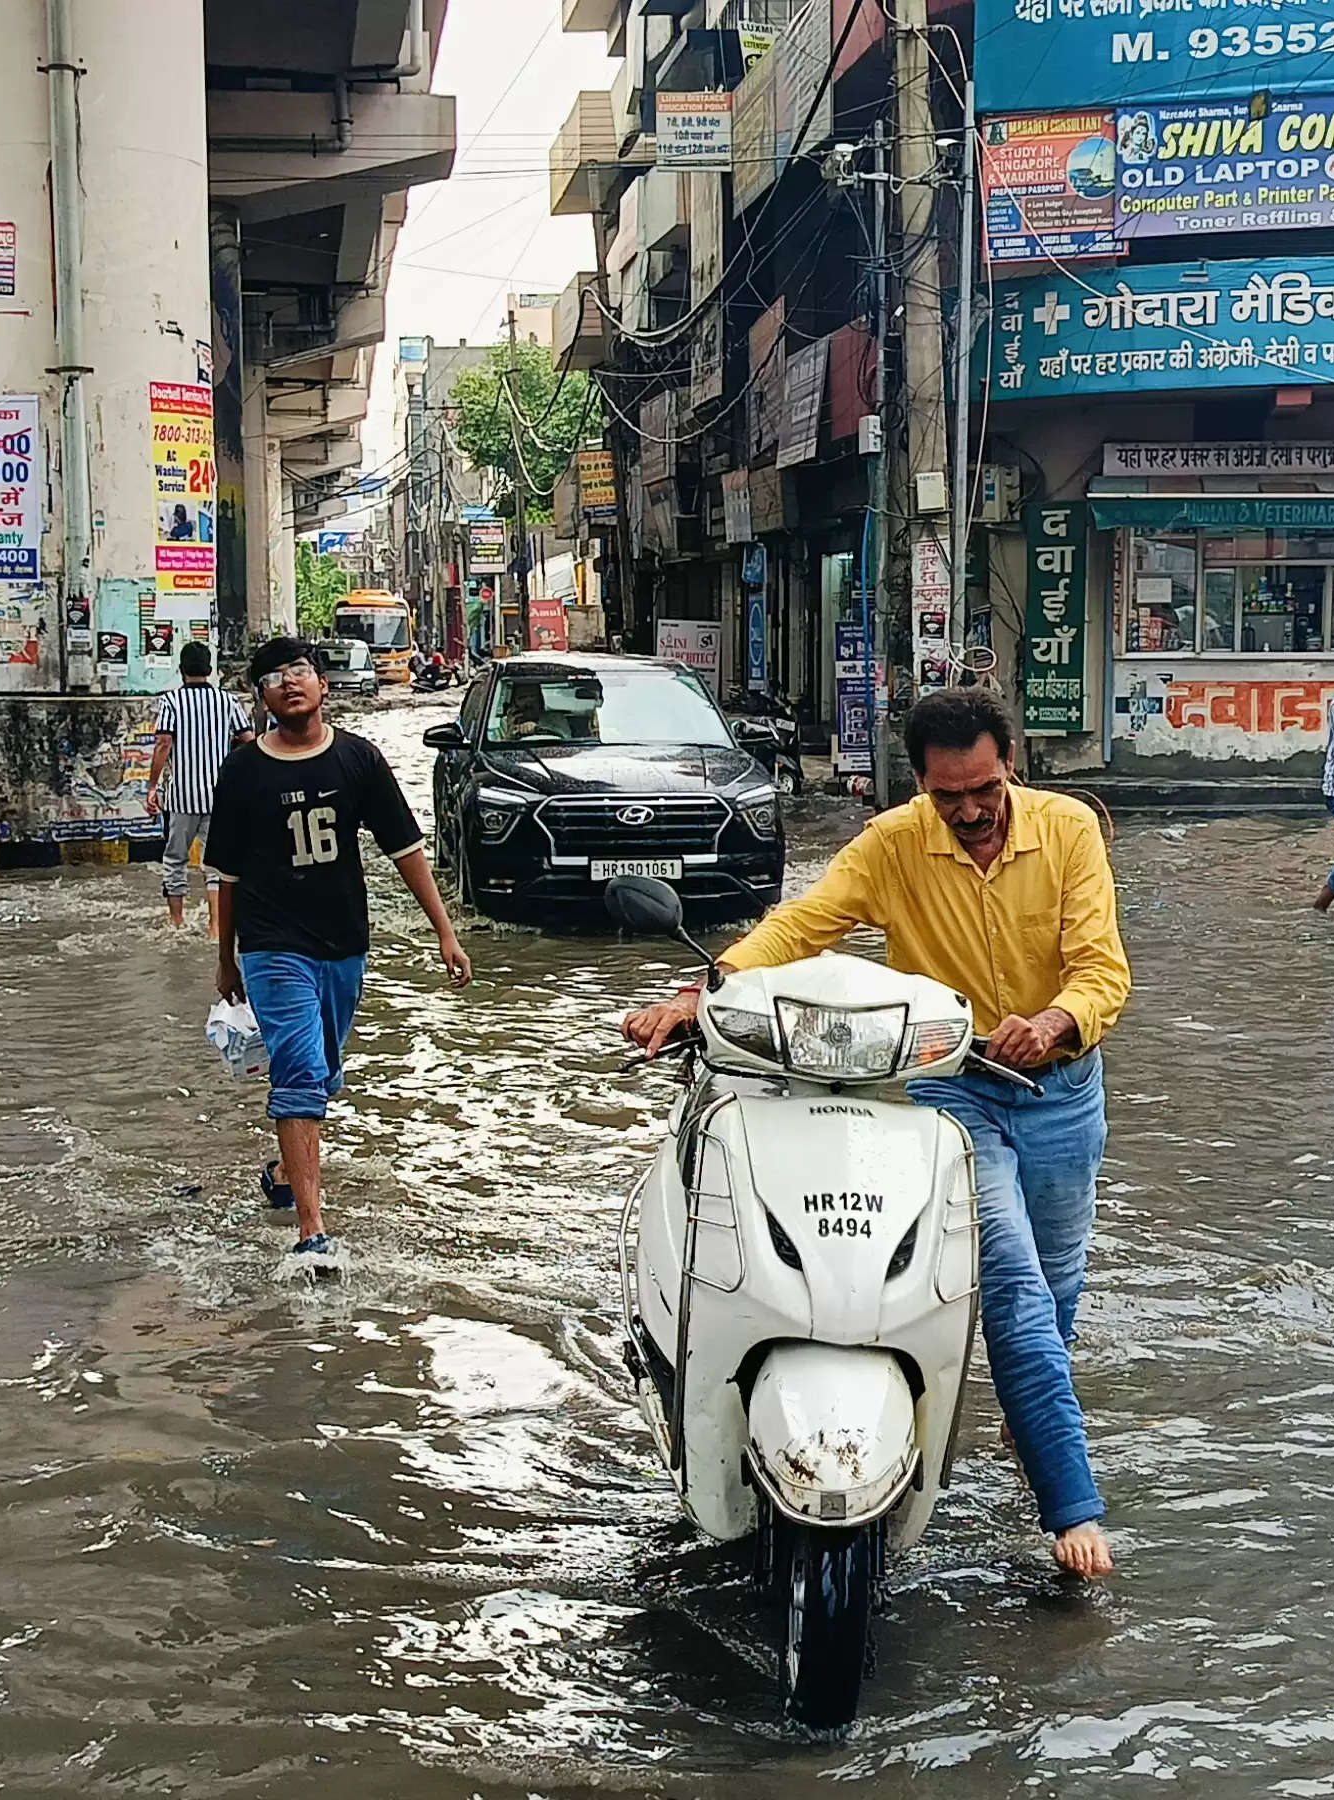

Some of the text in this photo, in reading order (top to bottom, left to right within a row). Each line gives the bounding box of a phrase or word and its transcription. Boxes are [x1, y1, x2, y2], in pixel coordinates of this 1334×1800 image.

[1157, 118, 1265, 160] SHIVA
[999, 145, 1054, 159] STUDY IN
[1122, 165, 1185, 188] OLD
[1194, 158, 1320, 185] LAPTOP
[1120, 193, 1200, 216] Computer
[1204, 189, 1238, 209] Part
[1242, 192, 1252, 206] &
[1257, 186, 1315, 206] Printer
[1175, 215, 1236, 231] Toner
[1242, 210, 1322, 228] Reffling
[1082, 281, 1220, 330] गोदारा
[1039, 347, 1070, 379] यहाँ
[1070, 352, 1092, 376] पर
[1095, 352, 1118, 377] हर
[1120, 350, 1167, 377] प्रकार
[1169, 339, 1193, 370] की
[1303, 343, 1318, 365] व
[166, 450, 177, 462] AC
[154, 464, 188, 480] Washing
[158, 480, 186, 492] Service
[529, 606, 562, 617] Amul
[287, 806, 338, 867] 16
[808, 1104, 876, 1119] HONDA
[817, 1217, 873, 1240] 8494
